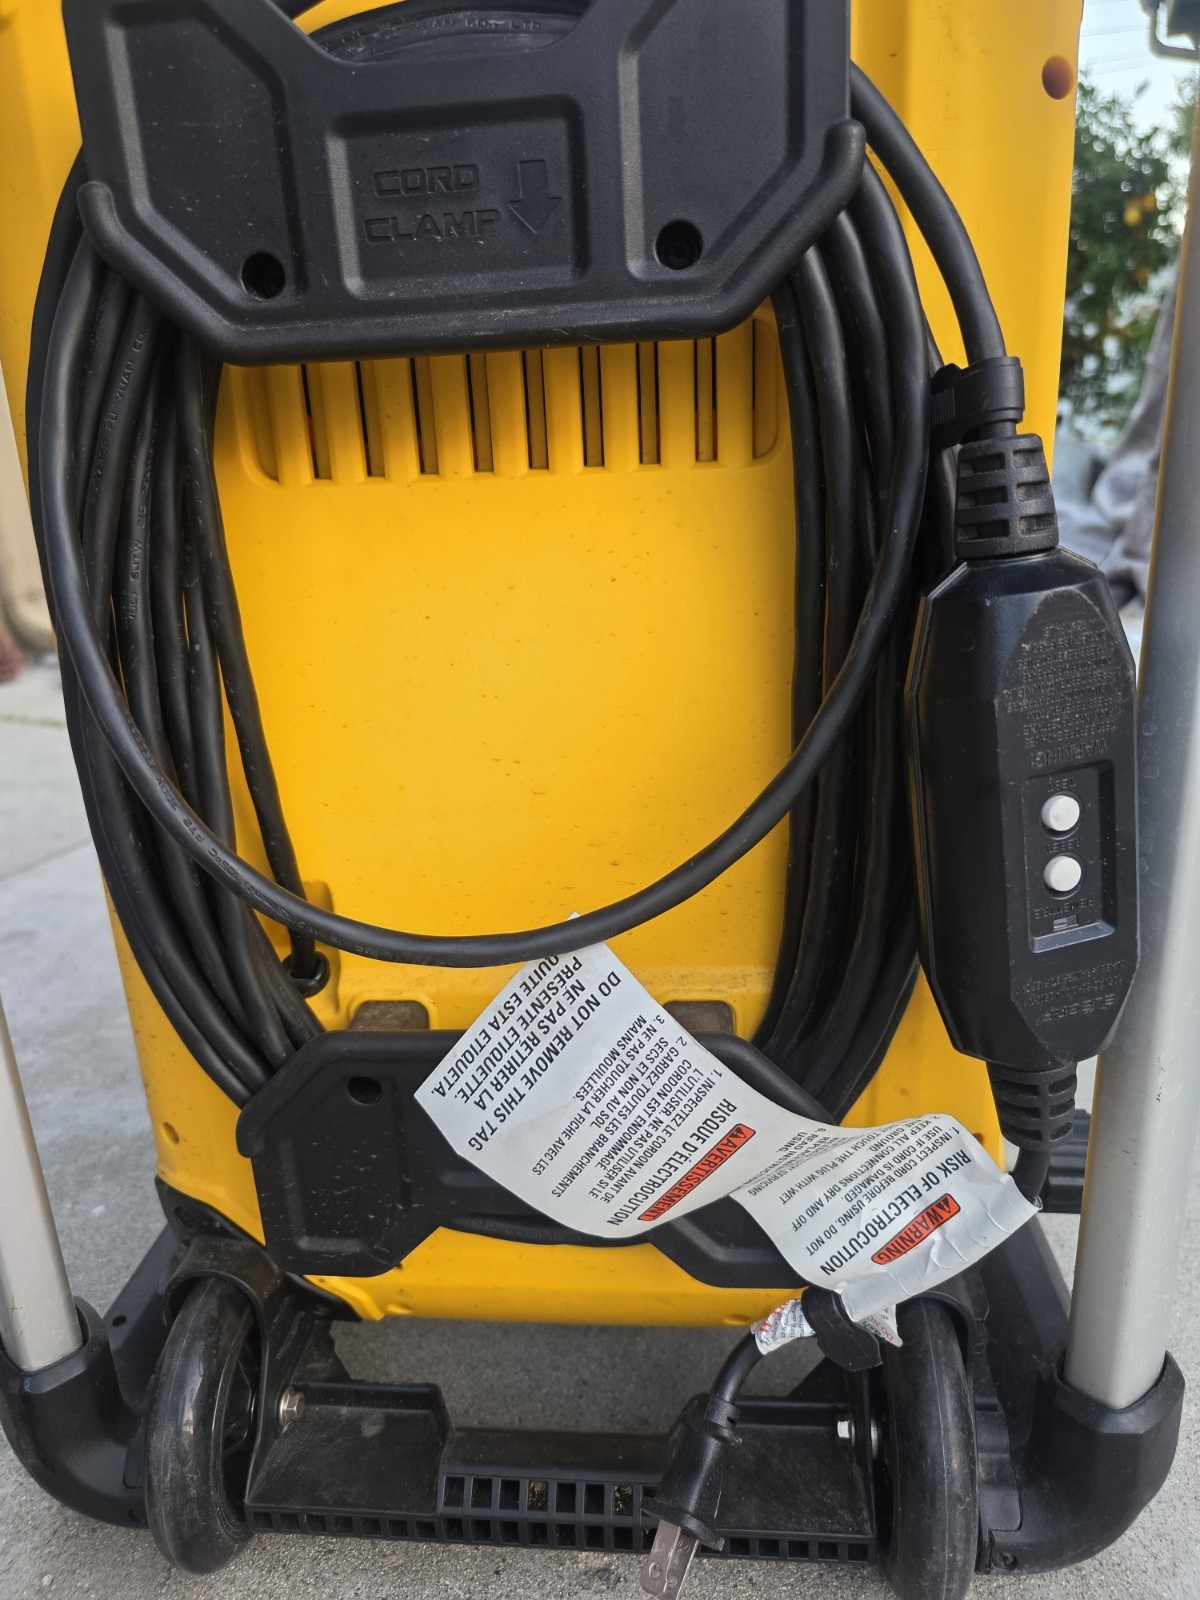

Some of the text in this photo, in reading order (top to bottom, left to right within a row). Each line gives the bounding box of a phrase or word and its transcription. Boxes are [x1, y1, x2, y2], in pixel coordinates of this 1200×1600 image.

[373, 164, 481, 198] CORD
[364, 209, 501, 244] CLAMP
[1048, 777, 1076, 791] TEST
[431, 953, 560, 1097] QUITE ESTA ETIQUETA.
[454, 956, 582, 1103] PRÉSENTE ÉTIQUETTE.
[473, 979, 585, 1110] NE PAS RETIRER LA
[468, 971, 621, 1150] DO NOT REMOVE THIS TAG
[572, 1014, 646, 1101] MAINS MOUILLÉES.
[532, 1014, 664, 1175] 3. NE PAS TOUCHER LA FICHE AVEC LES
[589, 1036, 668, 1128] SECS ET NON AU SOL.
[551, 1036, 687, 1197] 2. GARDEZ TOUTES LES BRANCHEMENTS
[588, 1068, 703, 1198] L'UTILISER. NE PAS UTILISER SI LE
[594, 1059, 691, 1170] CORDON EST ENDOMMAGÉ.
[908, 1118, 931, 1136] KEEP
[600, 1069, 722, 1203] 1. INSPECTEZ LE CORDON AVANT DE
[775, 1129, 807, 1156] USING.
[792, 1132, 817, 1151] READ
[834, 1147, 854, 1163] THE
[850, 1129, 880, 1152] TOUCH
[866, 1127, 904, 1151] GROUND.
[892, 1133, 909, 1145] ALL
[606, 1098, 737, 1225] RISQUE D'ÉLECTROCUTION
[643, 1137, 735, 1220] AVERTISSEMENT
[747, 1166, 787, 1197] SERVICING
[794, 1172, 818, 1190] WITH
[814, 1159, 838, 1177] PLUG
[838, 1145, 894, 1186] CONNECTIONS
[841, 1125, 942, 1202] USE IF CORD IS DAMAGED.
[777, 1186, 798, 1204] WET
[805, 1197, 823, 1217] AND
[806, 1126, 959, 1256] 1. INSPECT CORD BEFORE USING. DO NOT
[823, 1184, 841, 1202] DRY
[791, 1214, 806, 1231] OFF
[819, 1149, 971, 1275] RISK OF ELECTROCUTION
[876, 1206, 943, 1264] WARNING
